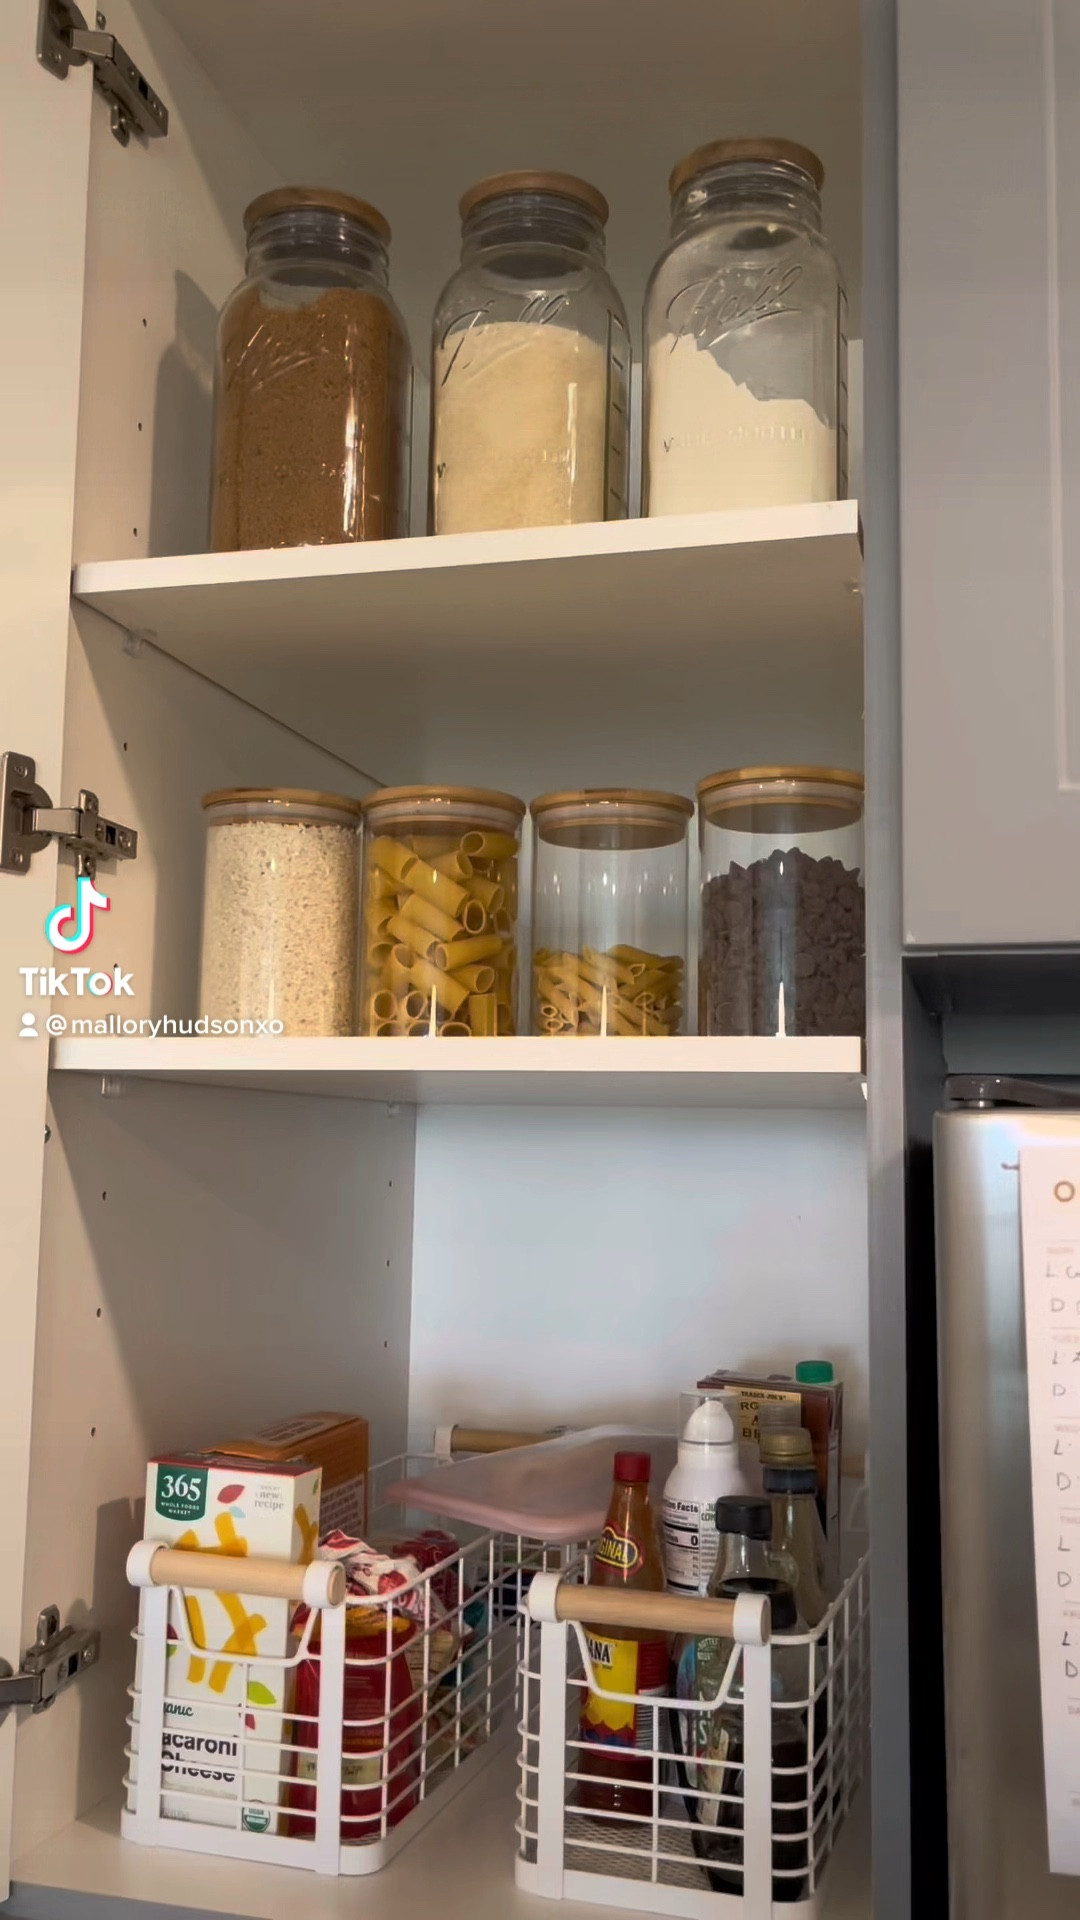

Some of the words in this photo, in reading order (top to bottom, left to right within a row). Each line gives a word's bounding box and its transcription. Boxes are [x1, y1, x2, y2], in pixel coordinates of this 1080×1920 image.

[161, 1473, 202, 1501] 365
[160, 1501, 180, 1509] WHOLE
[181, 1502, 200, 1511] FOODS
[254, 1500, 285, 1511] recipe
[677, 1502, 698, 1513] Facts
[168, 1508, 191, 1516] MARKET
[690, 1535, 698, 1546] 0
[1057, 1571, 1072, 1587] D
[1065, 1660, 1078, 1678] D
